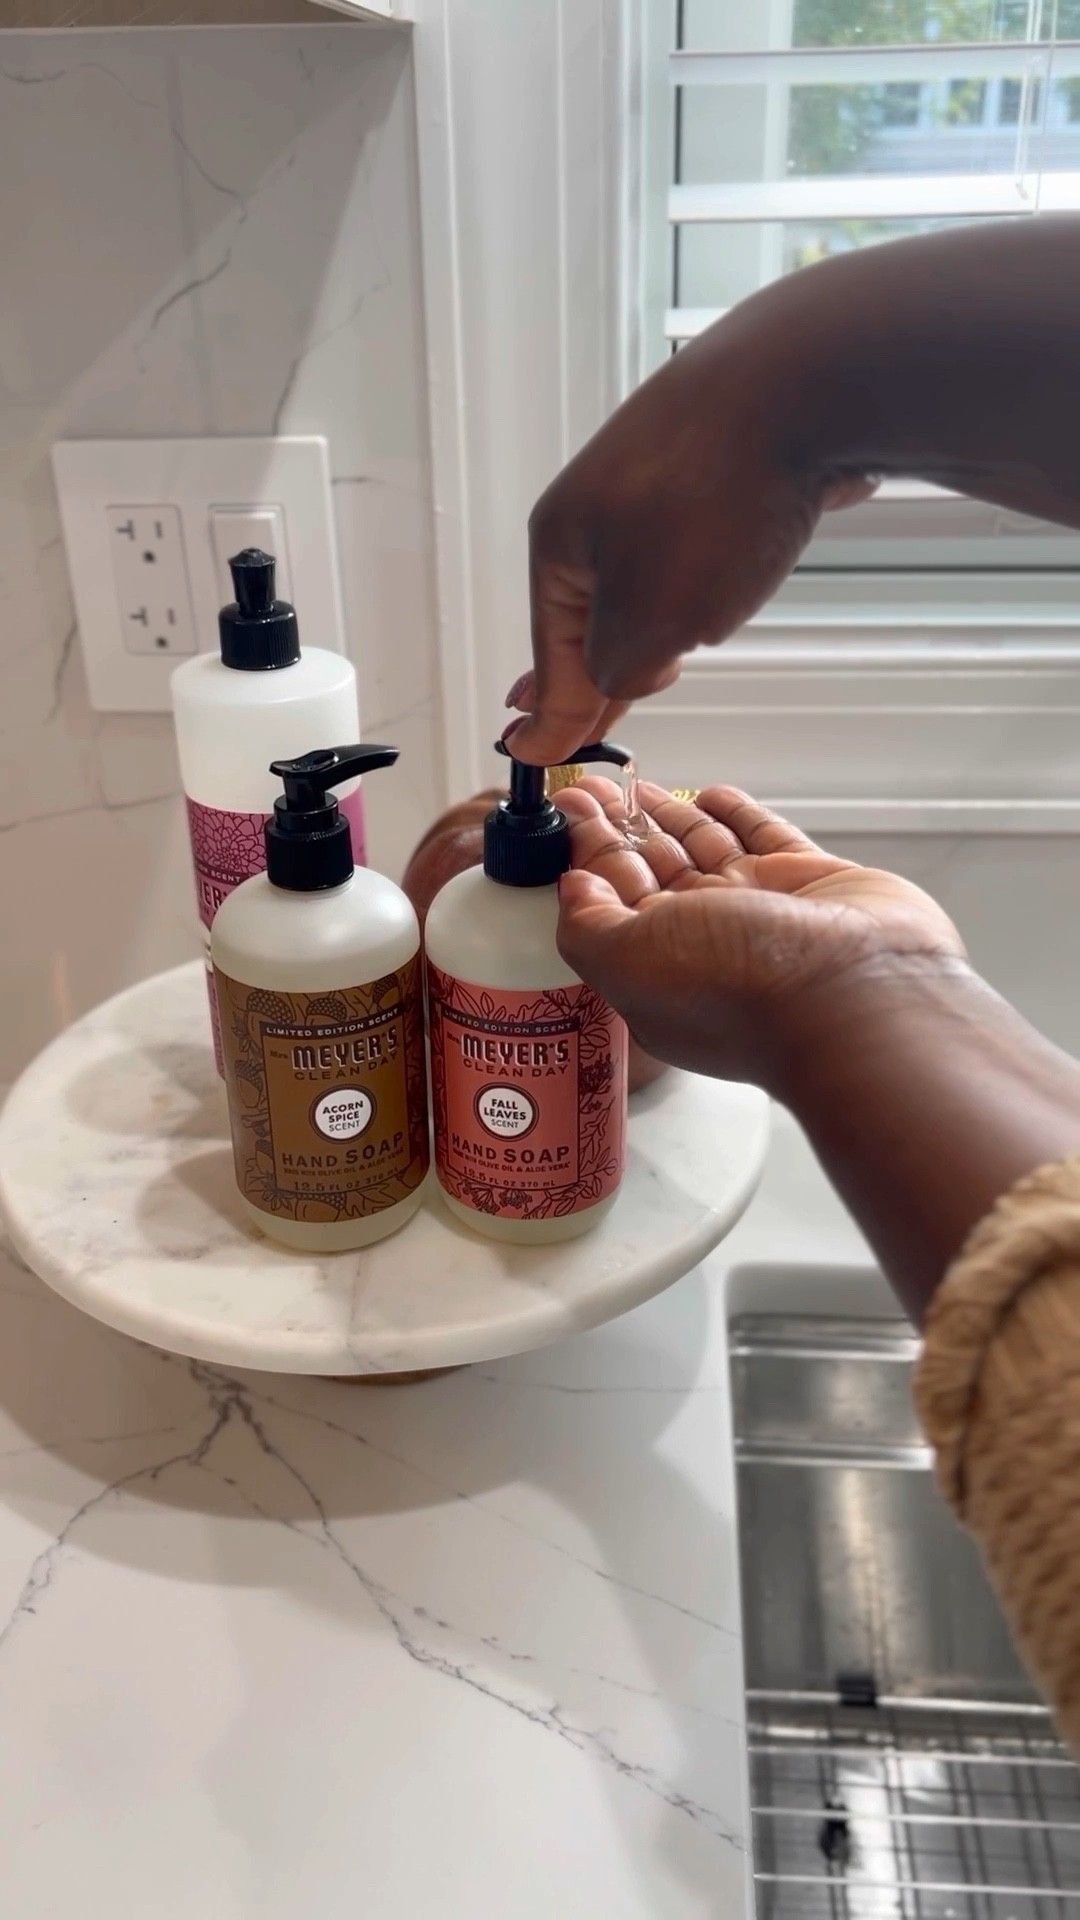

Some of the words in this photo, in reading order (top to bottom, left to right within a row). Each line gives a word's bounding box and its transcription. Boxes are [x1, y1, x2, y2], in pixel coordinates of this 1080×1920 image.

[211, 870, 240, 882] SCENT
[266, 1027, 313, 1036] LIMITED
[317, 1023, 364, 1036] EDITION
[368, 1008, 398, 1026] SCENT
[445, 1010, 479, 1027] LIMITED
[484, 1023, 530, 1033] EDITION
[535, 1023, 572, 1033] SCENT
[291, 1025, 397, 1070] MEYER'S
[461, 1033, 569, 1067] MEYER'S
[294, 1066, 360, 1080] CLEAN
[368, 1052, 397, 1071] DAY
[463, 1058, 523, 1077] CLEAN
[532, 1065, 568, 1077] DAY
[322, 1100, 364, 1114] ACORN
[491, 1098, 518, 1110] FALL
[328, 1111, 360, 1123] SPICE
[484, 1107, 526, 1120] LEAVES
[328, 1120, 360, 1132] SCENT
[491, 1119, 519, 1129] SCENT
[282, 1152, 338, 1168] HAND
[345, 1131, 403, 1164] SOAP
[452, 1133, 497, 1159] HAND
[503, 1146, 570, 1164] SOAP
[318, 1168, 340, 1177] OLIVE
[478, 1159, 499, 1170] OLIVE
[525, 1164, 546, 1172] ALOE
[463, 1166, 487, 1182] 12.5
[294, 1181, 325, 1192] 12.5
[346, 1181, 360, 1189] OZ
